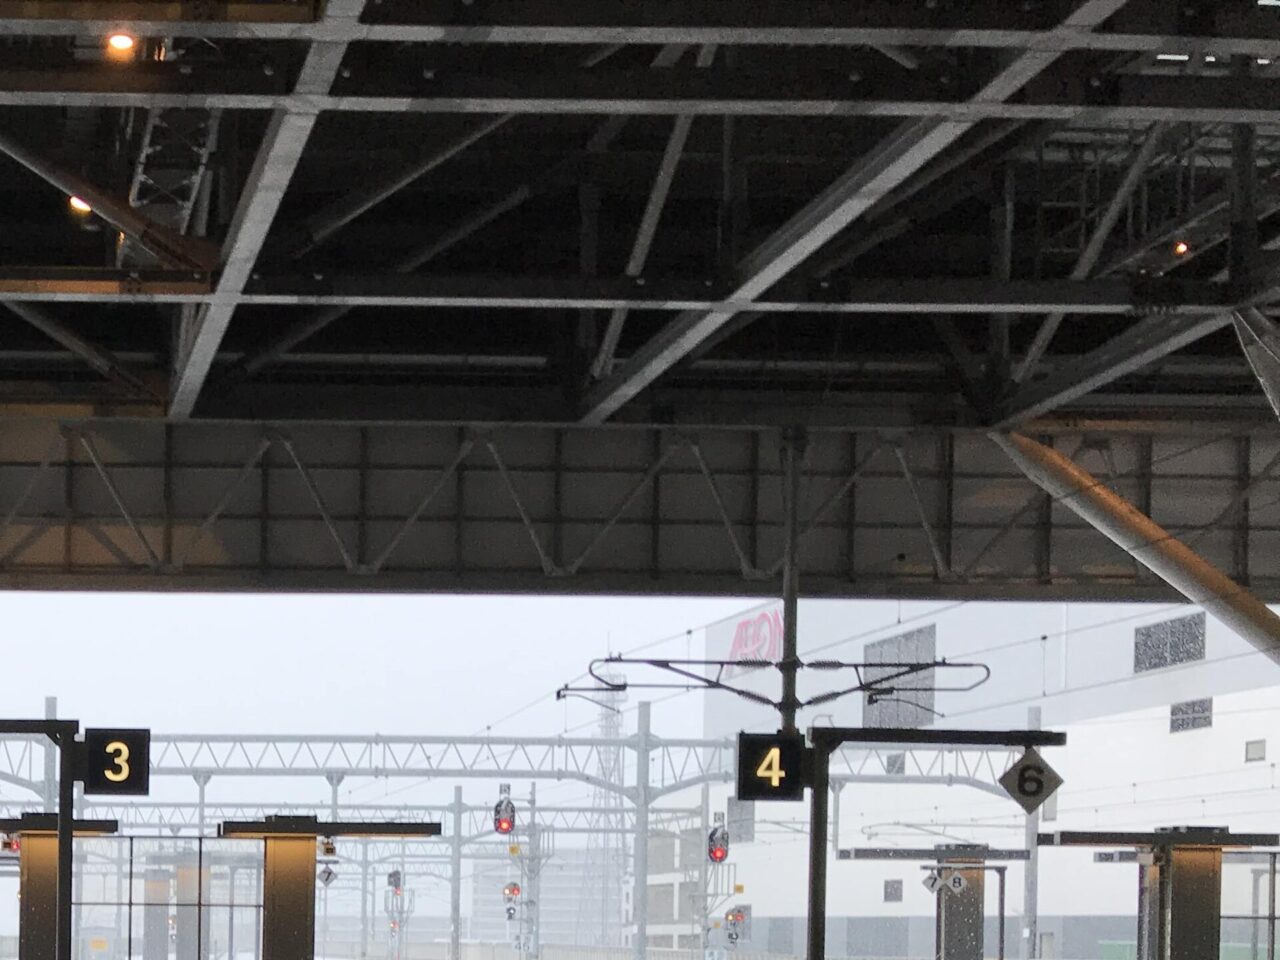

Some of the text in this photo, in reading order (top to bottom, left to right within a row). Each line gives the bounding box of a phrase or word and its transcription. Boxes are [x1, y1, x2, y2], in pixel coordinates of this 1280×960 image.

[104, 741, 130, 782] 3
[756, 746, 786, 787] 4
[1017, 764, 1045, 797] 6
[323, 870, 332, 881] 7
[928, 876, 937, 888] 7
[953, 876, 962, 888] 8
